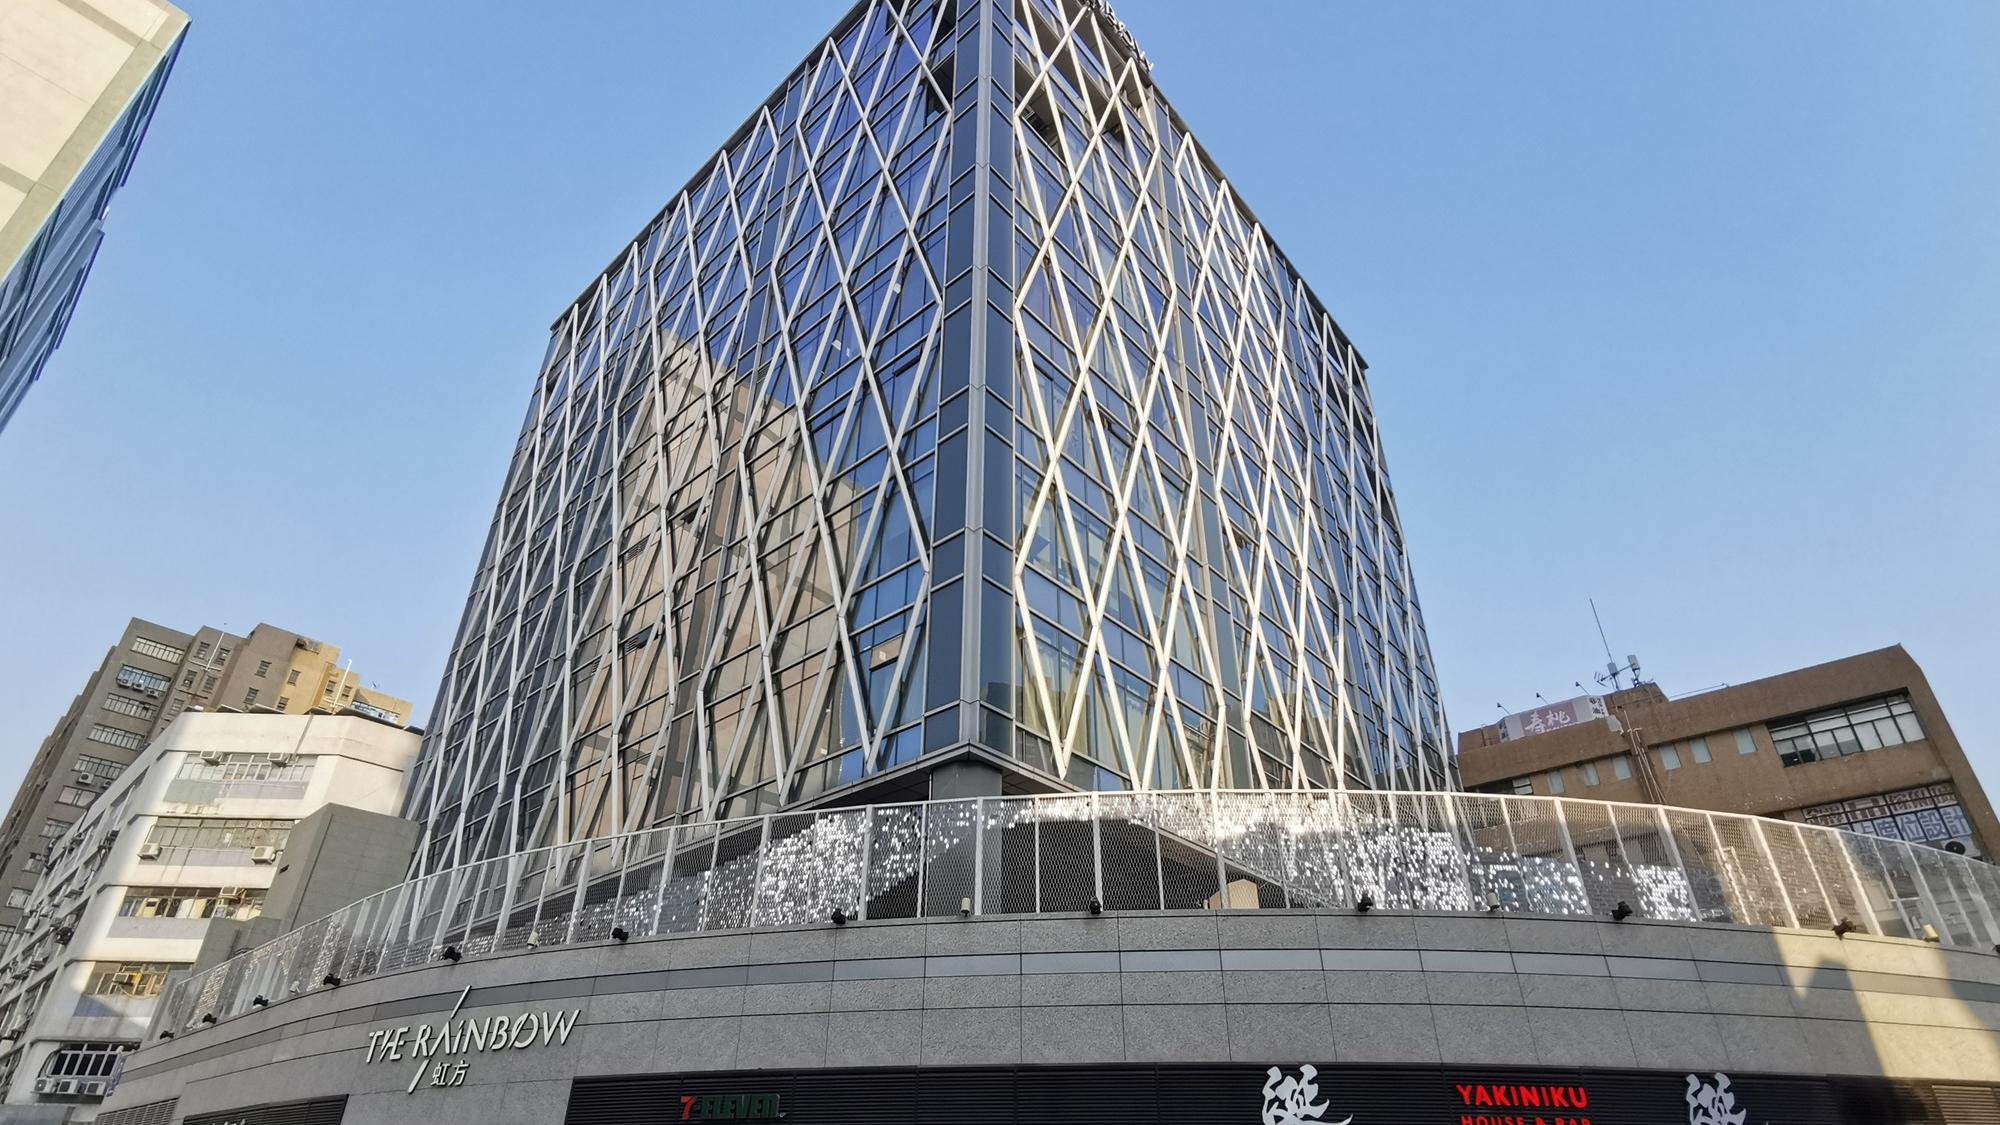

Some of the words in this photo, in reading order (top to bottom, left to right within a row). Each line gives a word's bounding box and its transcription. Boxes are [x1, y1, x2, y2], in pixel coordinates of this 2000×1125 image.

[367, 1026, 410, 1063] THE
[412, 1009, 581, 1057] RAINBOW
[431, 1060, 470, 1087] 虹方
[1456, 1084, 1588, 1108] YAKINIKU
[1460, 1115, 1524, 1125] HOUSE
[1554, 1117, 1591, 1125] BAR
